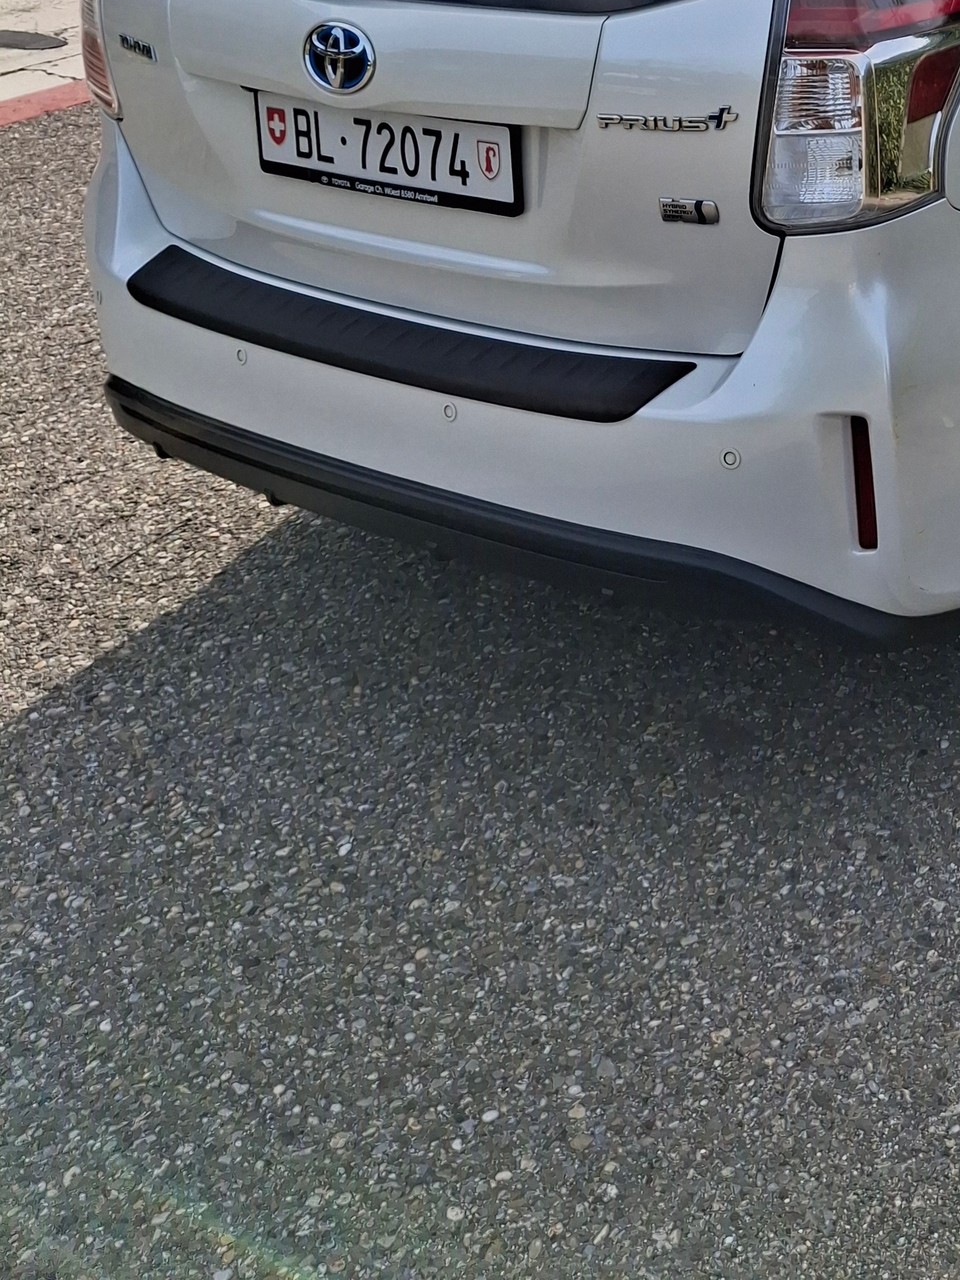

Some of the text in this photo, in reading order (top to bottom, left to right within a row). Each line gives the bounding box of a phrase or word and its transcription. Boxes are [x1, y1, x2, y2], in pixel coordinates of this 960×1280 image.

[332, 177, 351, 188] TOYOTA
[355, 181, 375, 194] Garage
[401, 189, 415, 200] 8580
